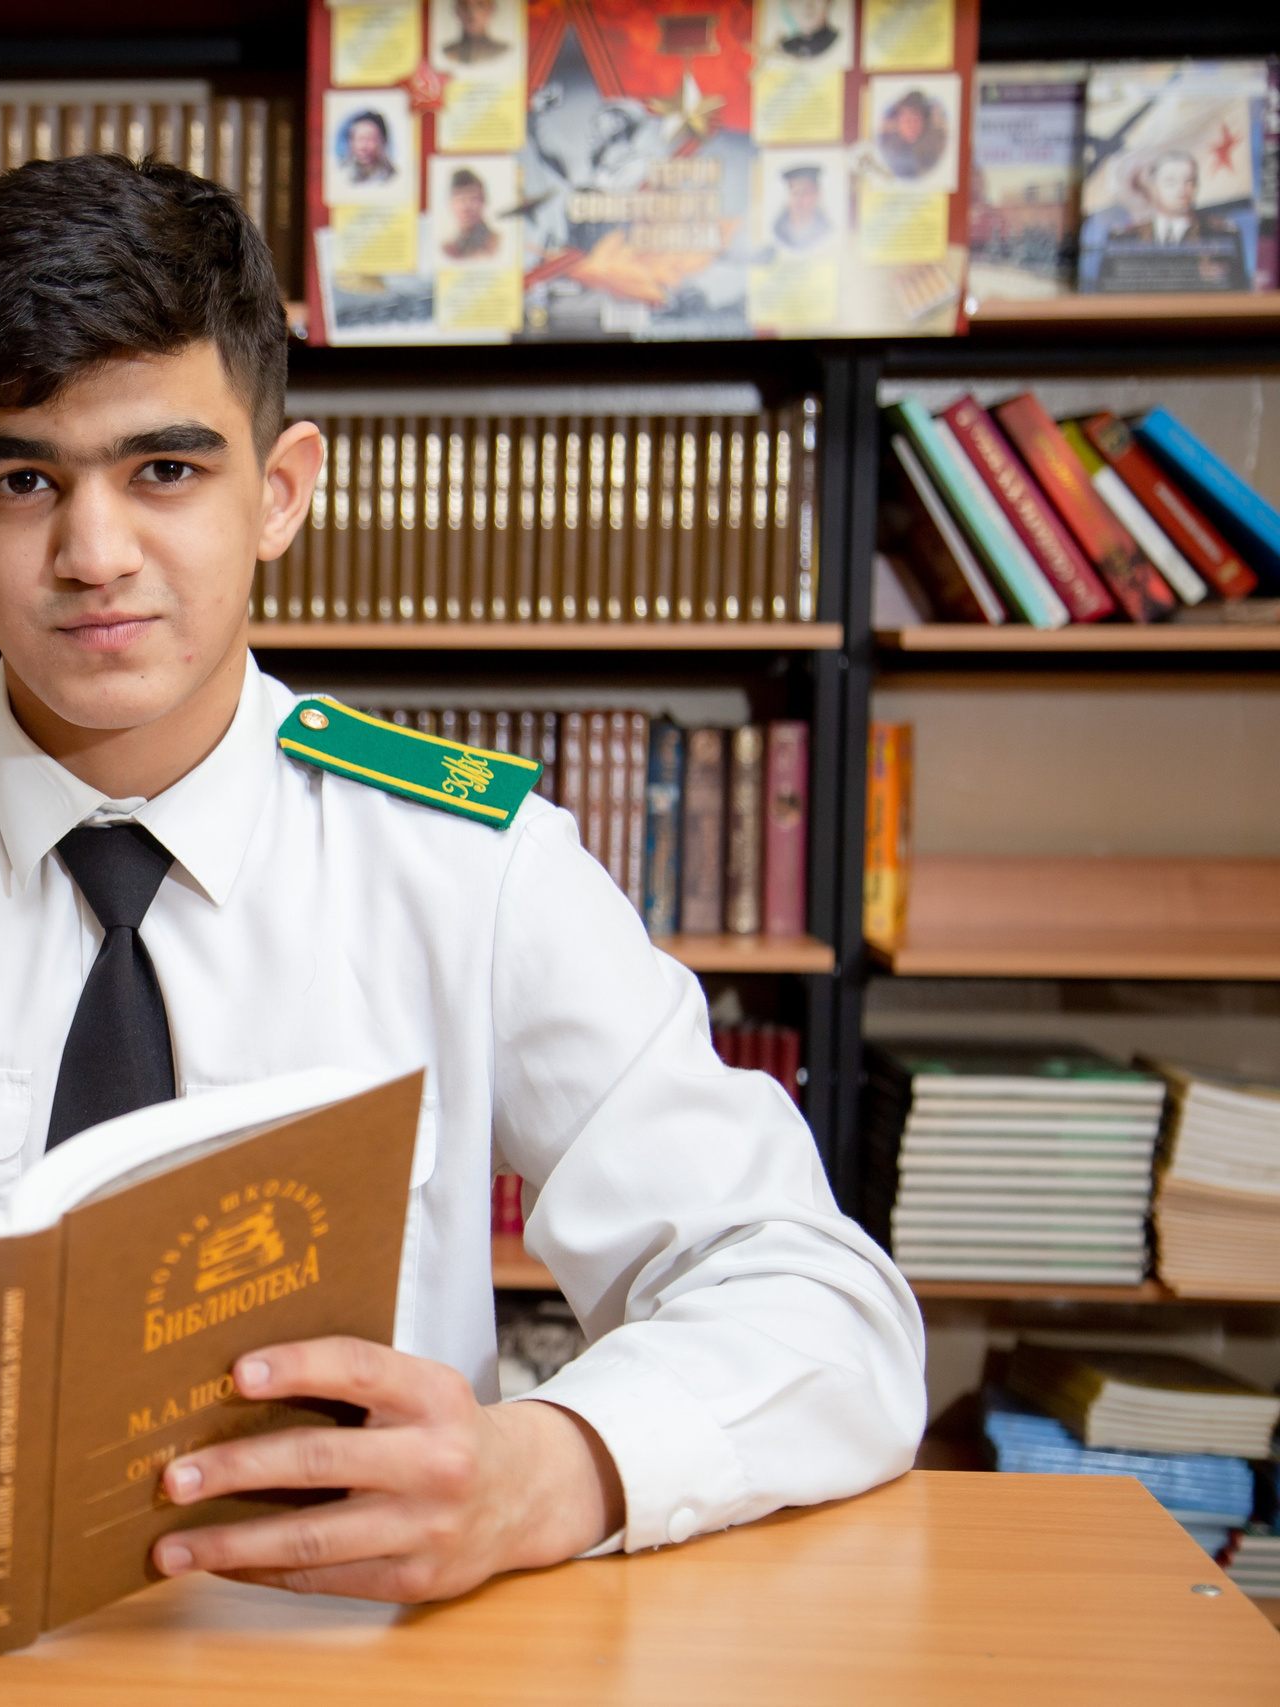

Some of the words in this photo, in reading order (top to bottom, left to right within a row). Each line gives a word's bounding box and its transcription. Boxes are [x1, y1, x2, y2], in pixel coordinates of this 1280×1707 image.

[145, 1213, 211, 1304] НОВАЯ
[219, 1178, 329, 1238] ШКОЛЬНАЯ
[143, 1243, 320, 1353] БИБЛИОТЕКА
[127, 1406, 158, 1438] М.
[161, 1396, 187, 1424] А.
